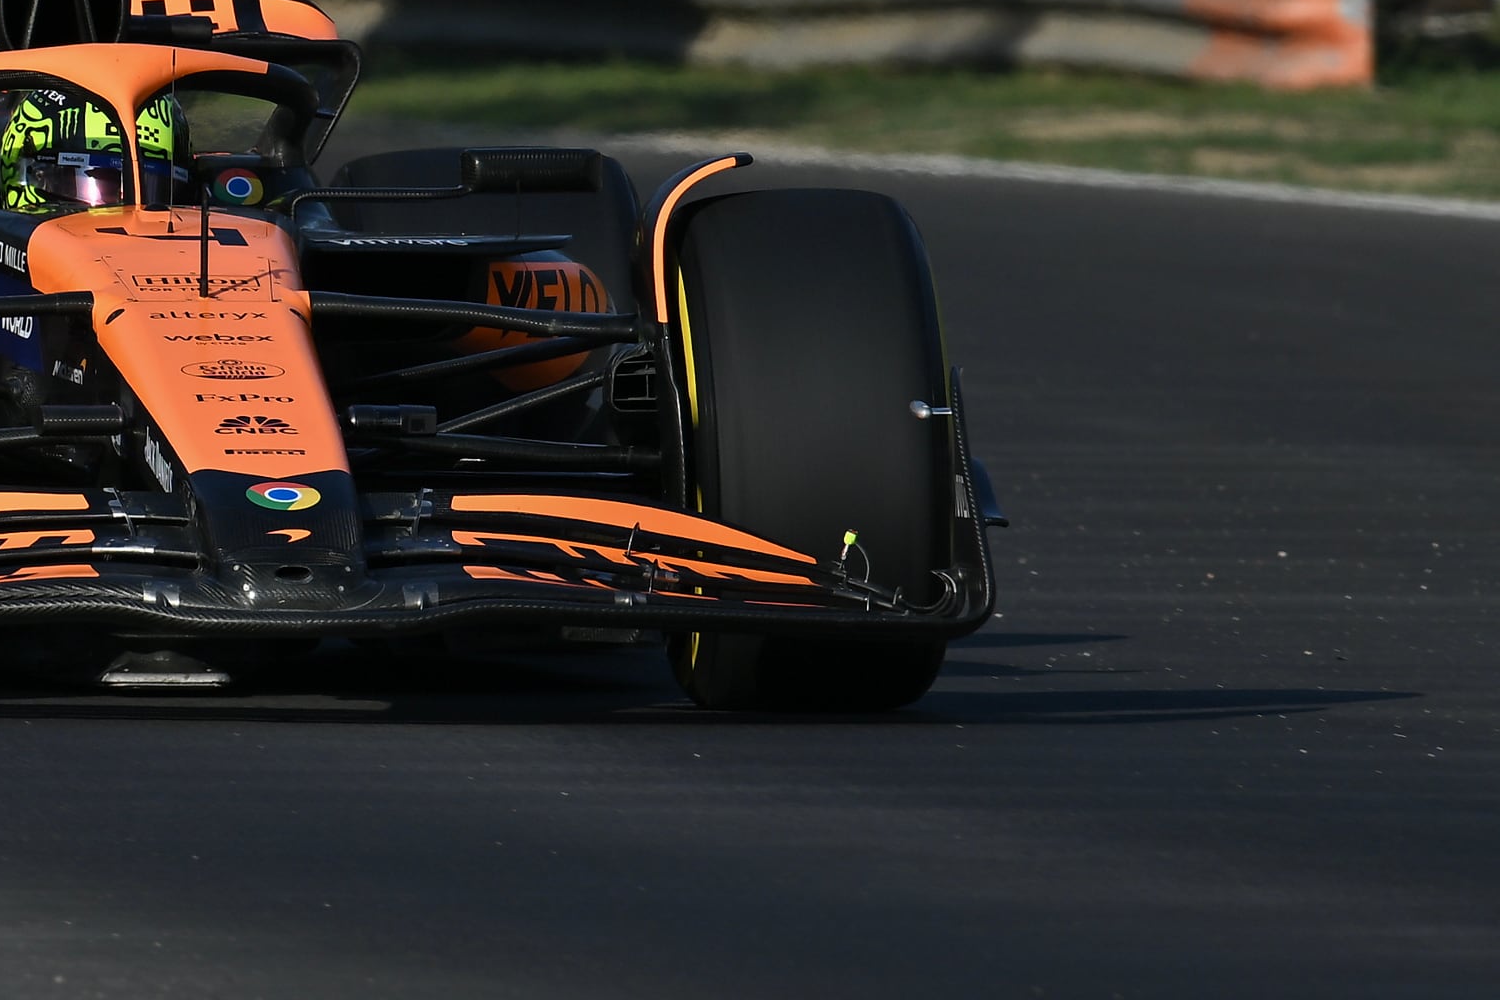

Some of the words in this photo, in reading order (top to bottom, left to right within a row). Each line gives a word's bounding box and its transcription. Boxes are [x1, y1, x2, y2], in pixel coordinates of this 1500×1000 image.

[4, 244, 27, 273] MILLE
[150, 311, 267, 321] alteryx
[164, 333, 274, 342] webex
[195, 393, 295, 403] FxPro
[214, 427, 300, 435] CNBC
